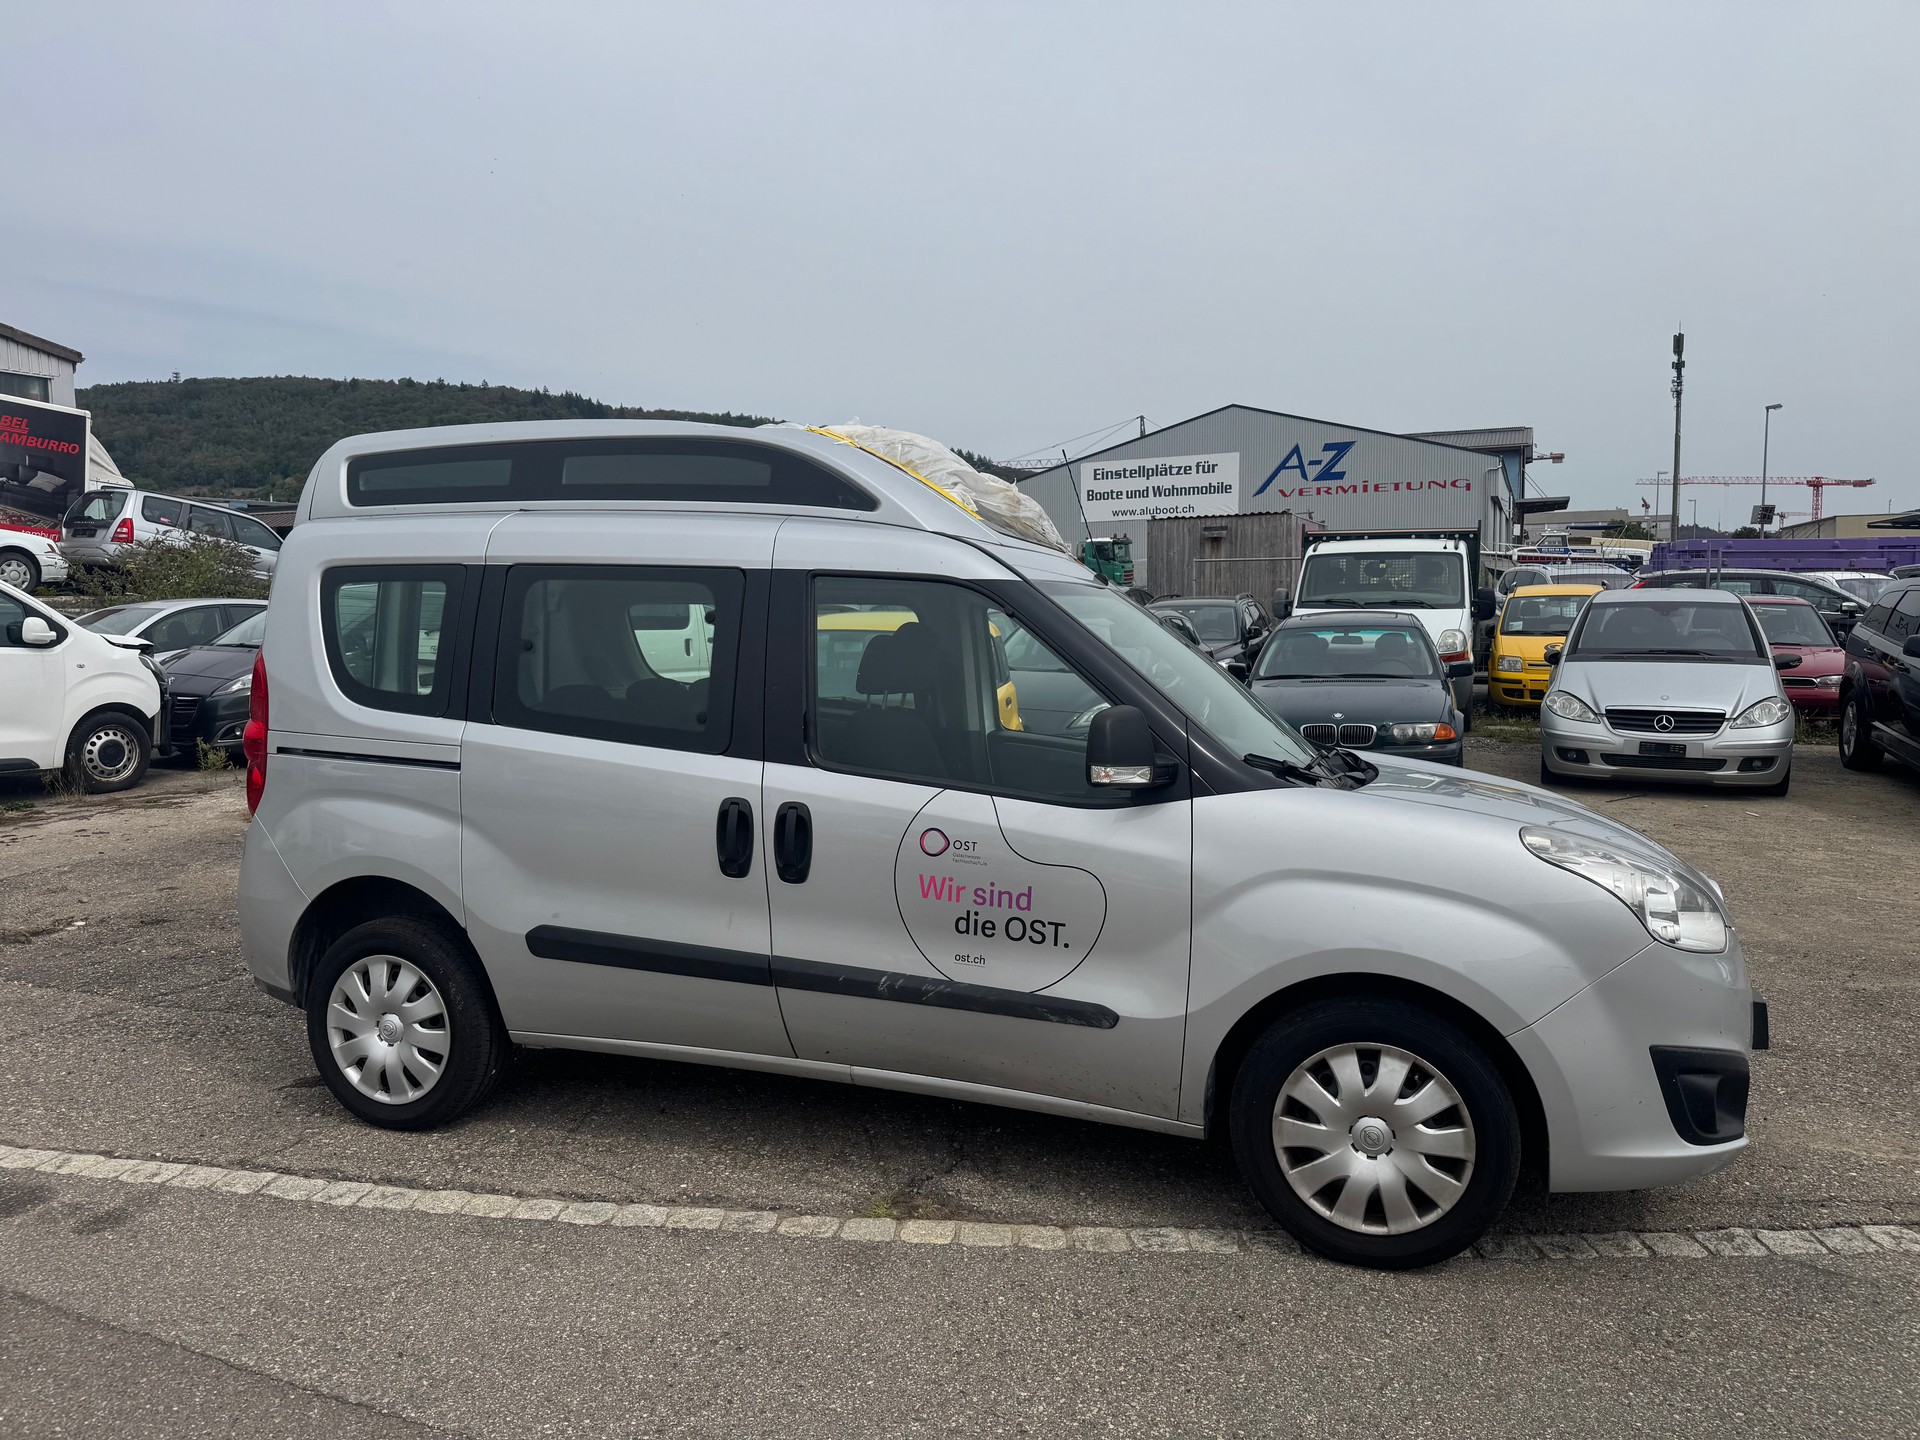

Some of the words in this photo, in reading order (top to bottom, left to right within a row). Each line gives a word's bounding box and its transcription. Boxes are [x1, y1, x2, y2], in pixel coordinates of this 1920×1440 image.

[1093, 463, 1192, 481] Einstellplätze
[1195, 460, 1218, 475] für
[1252, 440, 1357, 498] A-Z
[1086, 489, 1123, 501] Boote
[1126, 486, 1149, 499] und
[1152, 482, 1232, 498] Wohnmobile
[1112, 504, 1195, 517] www.aluboot.ch
[953, 840, 978, 851] OST
[918, 873, 966, 903] Wir
[972, 881, 1032, 912] sind
[954, 910, 996, 938] die
[1004, 916, 1070, 949] OST.
[954, 953, 986, 965] ost.ch
